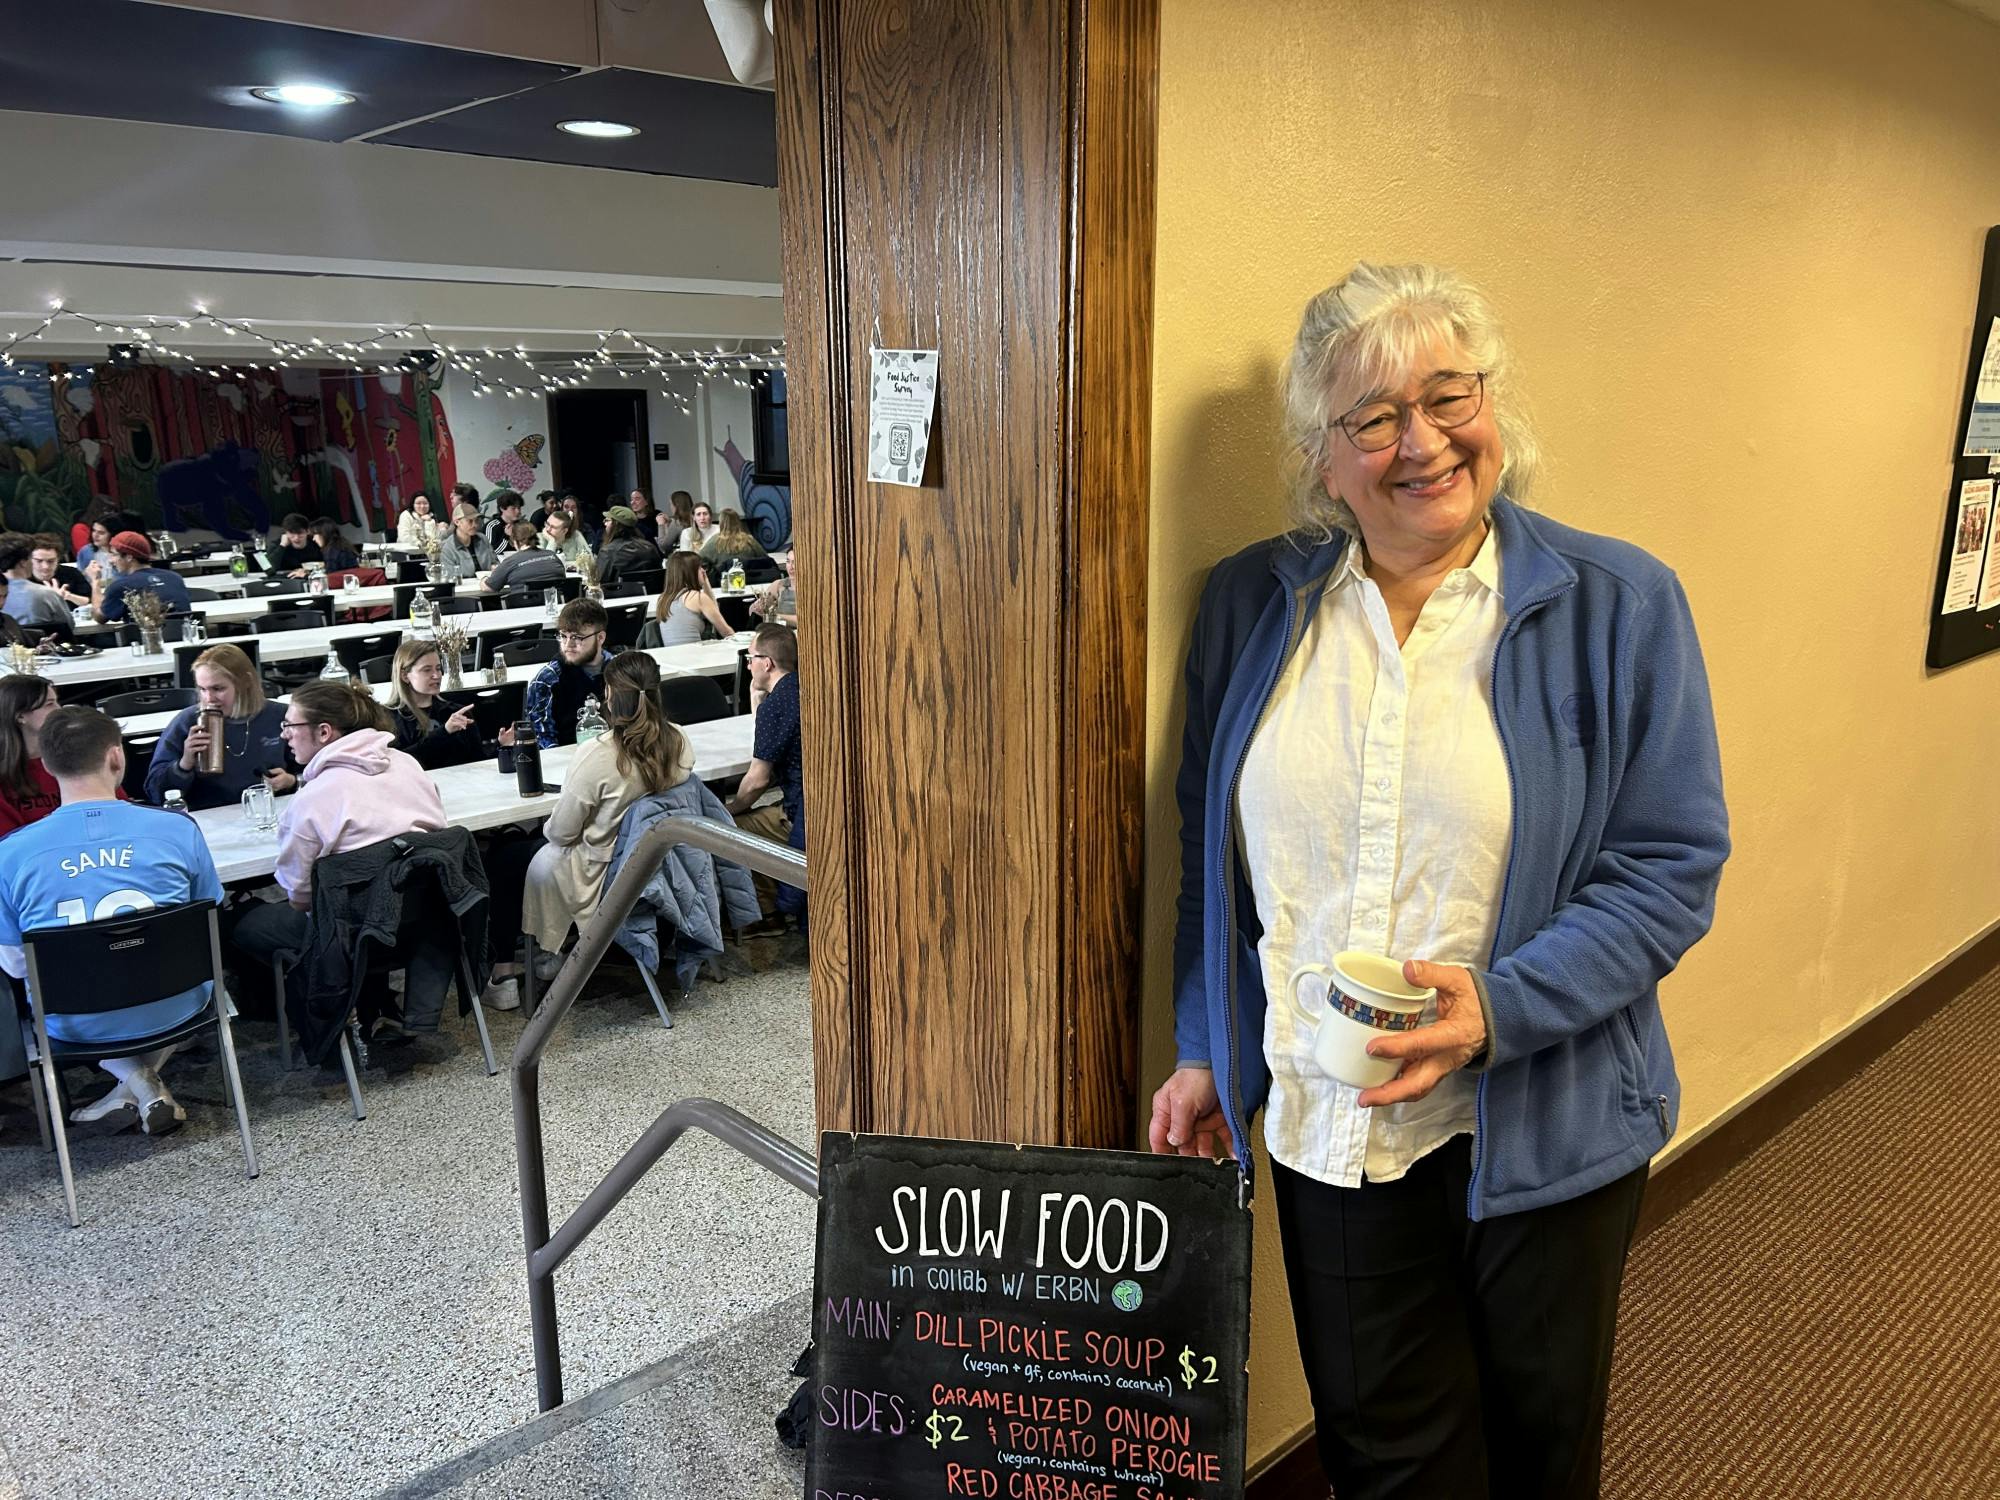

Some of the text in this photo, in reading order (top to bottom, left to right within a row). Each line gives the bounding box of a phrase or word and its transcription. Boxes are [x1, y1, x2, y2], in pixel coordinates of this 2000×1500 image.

[60, 845, 134, 878] SANÉ
[875, 1186, 1169, 1273] SLOW FOOD
[891, 1264, 914, 1288] in
[927, 1267, 987, 1293] collab
[1036, 1276, 1099, 1304] ERBN
[826, 1296, 1219, 1390] MAIN: DILL PICKLE SOUP $2
[963, 1353, 1008, 1378] (vegan
[1024, 1364, 1044, 1383] gf,
[1047, 1369, 1111, 1387] contains
[820, 1383, 1190, 1447] SIDES: CARAMELIZED ONION
[925, 1409, 970, 1449] $2
[1009, 1422, 1096, 1458] POTATO
[1112, 1438, 1221, 1482] PEROGIE
[946, 1463, 998, 1498] RED
[1009, 1472, 1118, 1500] CABBAGE
[1049, 1458, 1107, 1477] contains
[1114, 1469, 1164, 1487] wheat)
